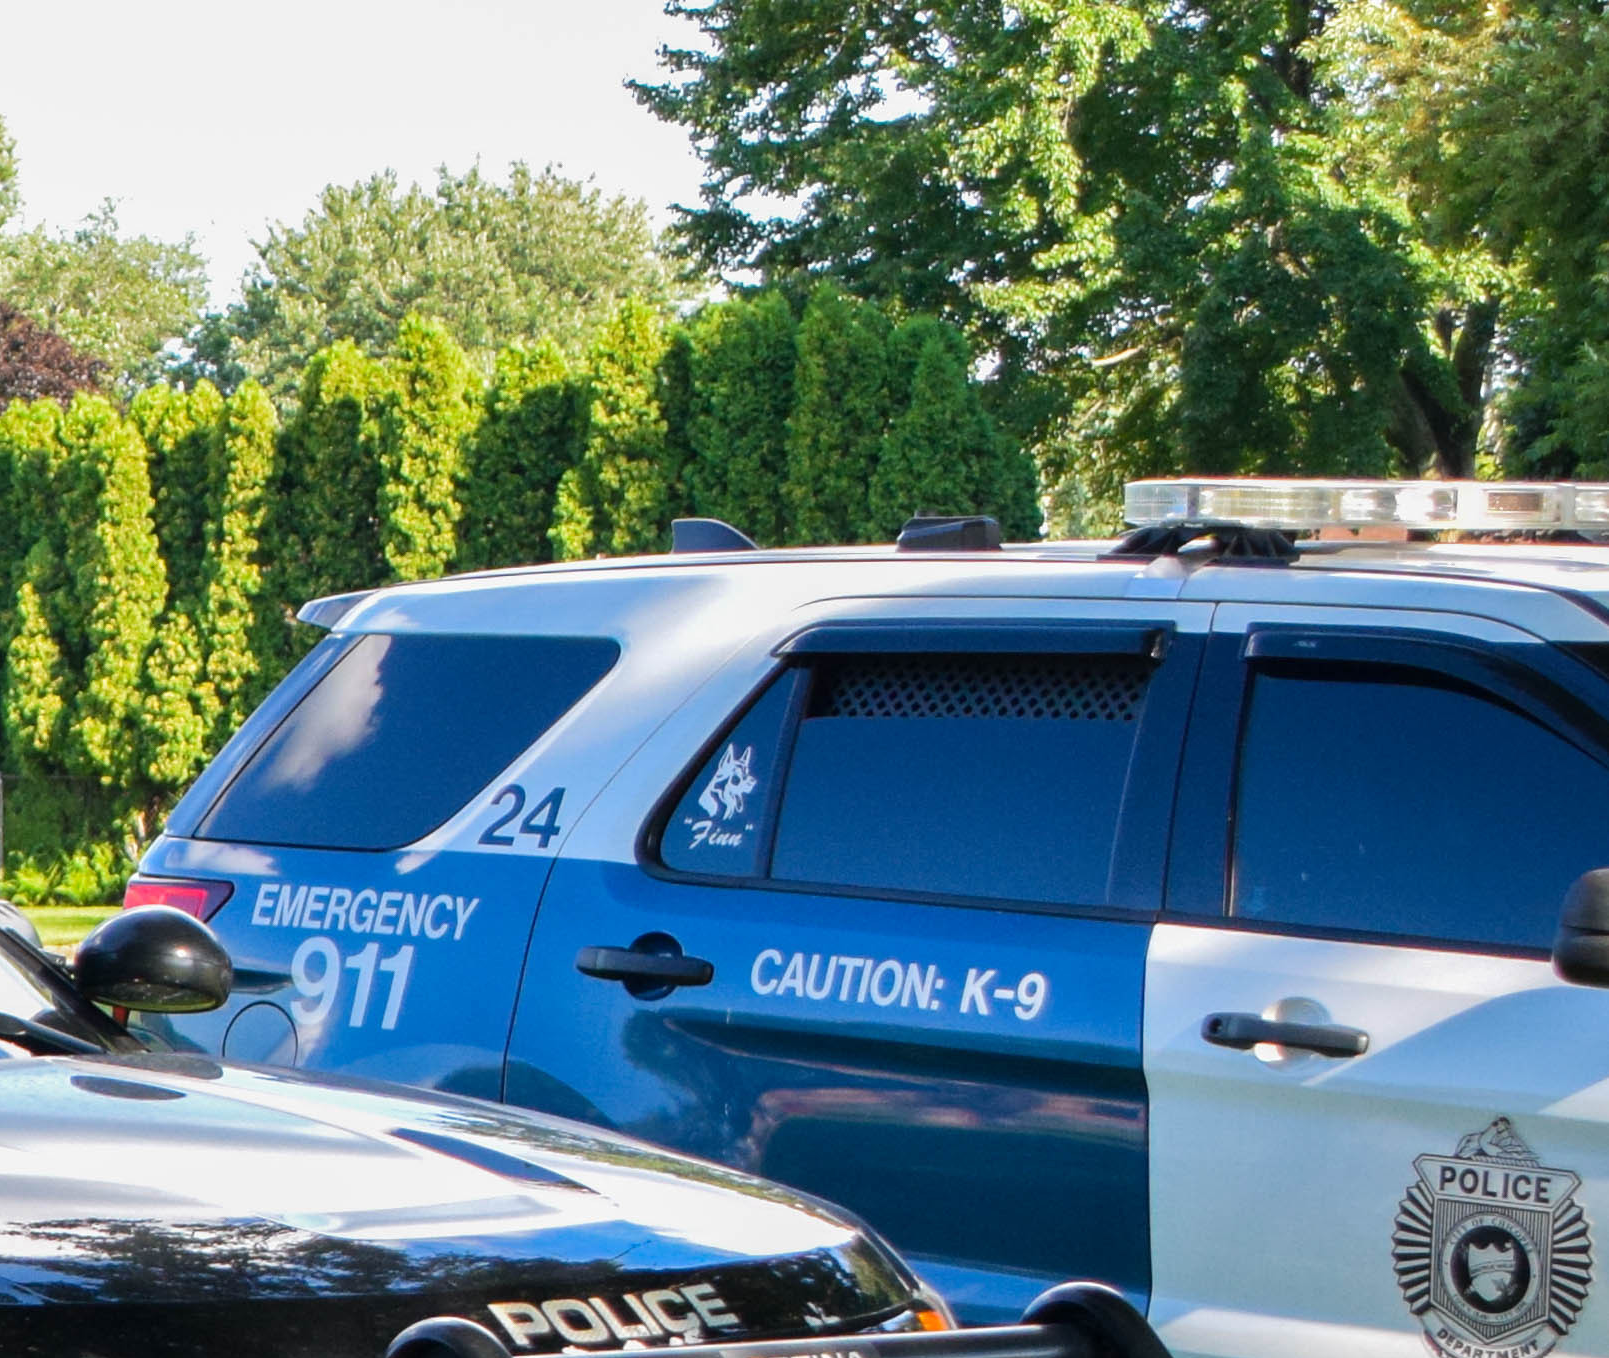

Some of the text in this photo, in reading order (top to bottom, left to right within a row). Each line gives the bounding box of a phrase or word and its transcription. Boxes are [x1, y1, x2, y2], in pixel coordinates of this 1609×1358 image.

[478, 784, 566, 848] 24
[251, 883, 480, 941] EMERGENCY
[290, 936, 415, 1031] 911
[750, 948, 1047, 1021] CAUTION: K-9
[1439, 1165, 1551, 1204] POLICE
[486, 1283, 740, 1348] POLICE
